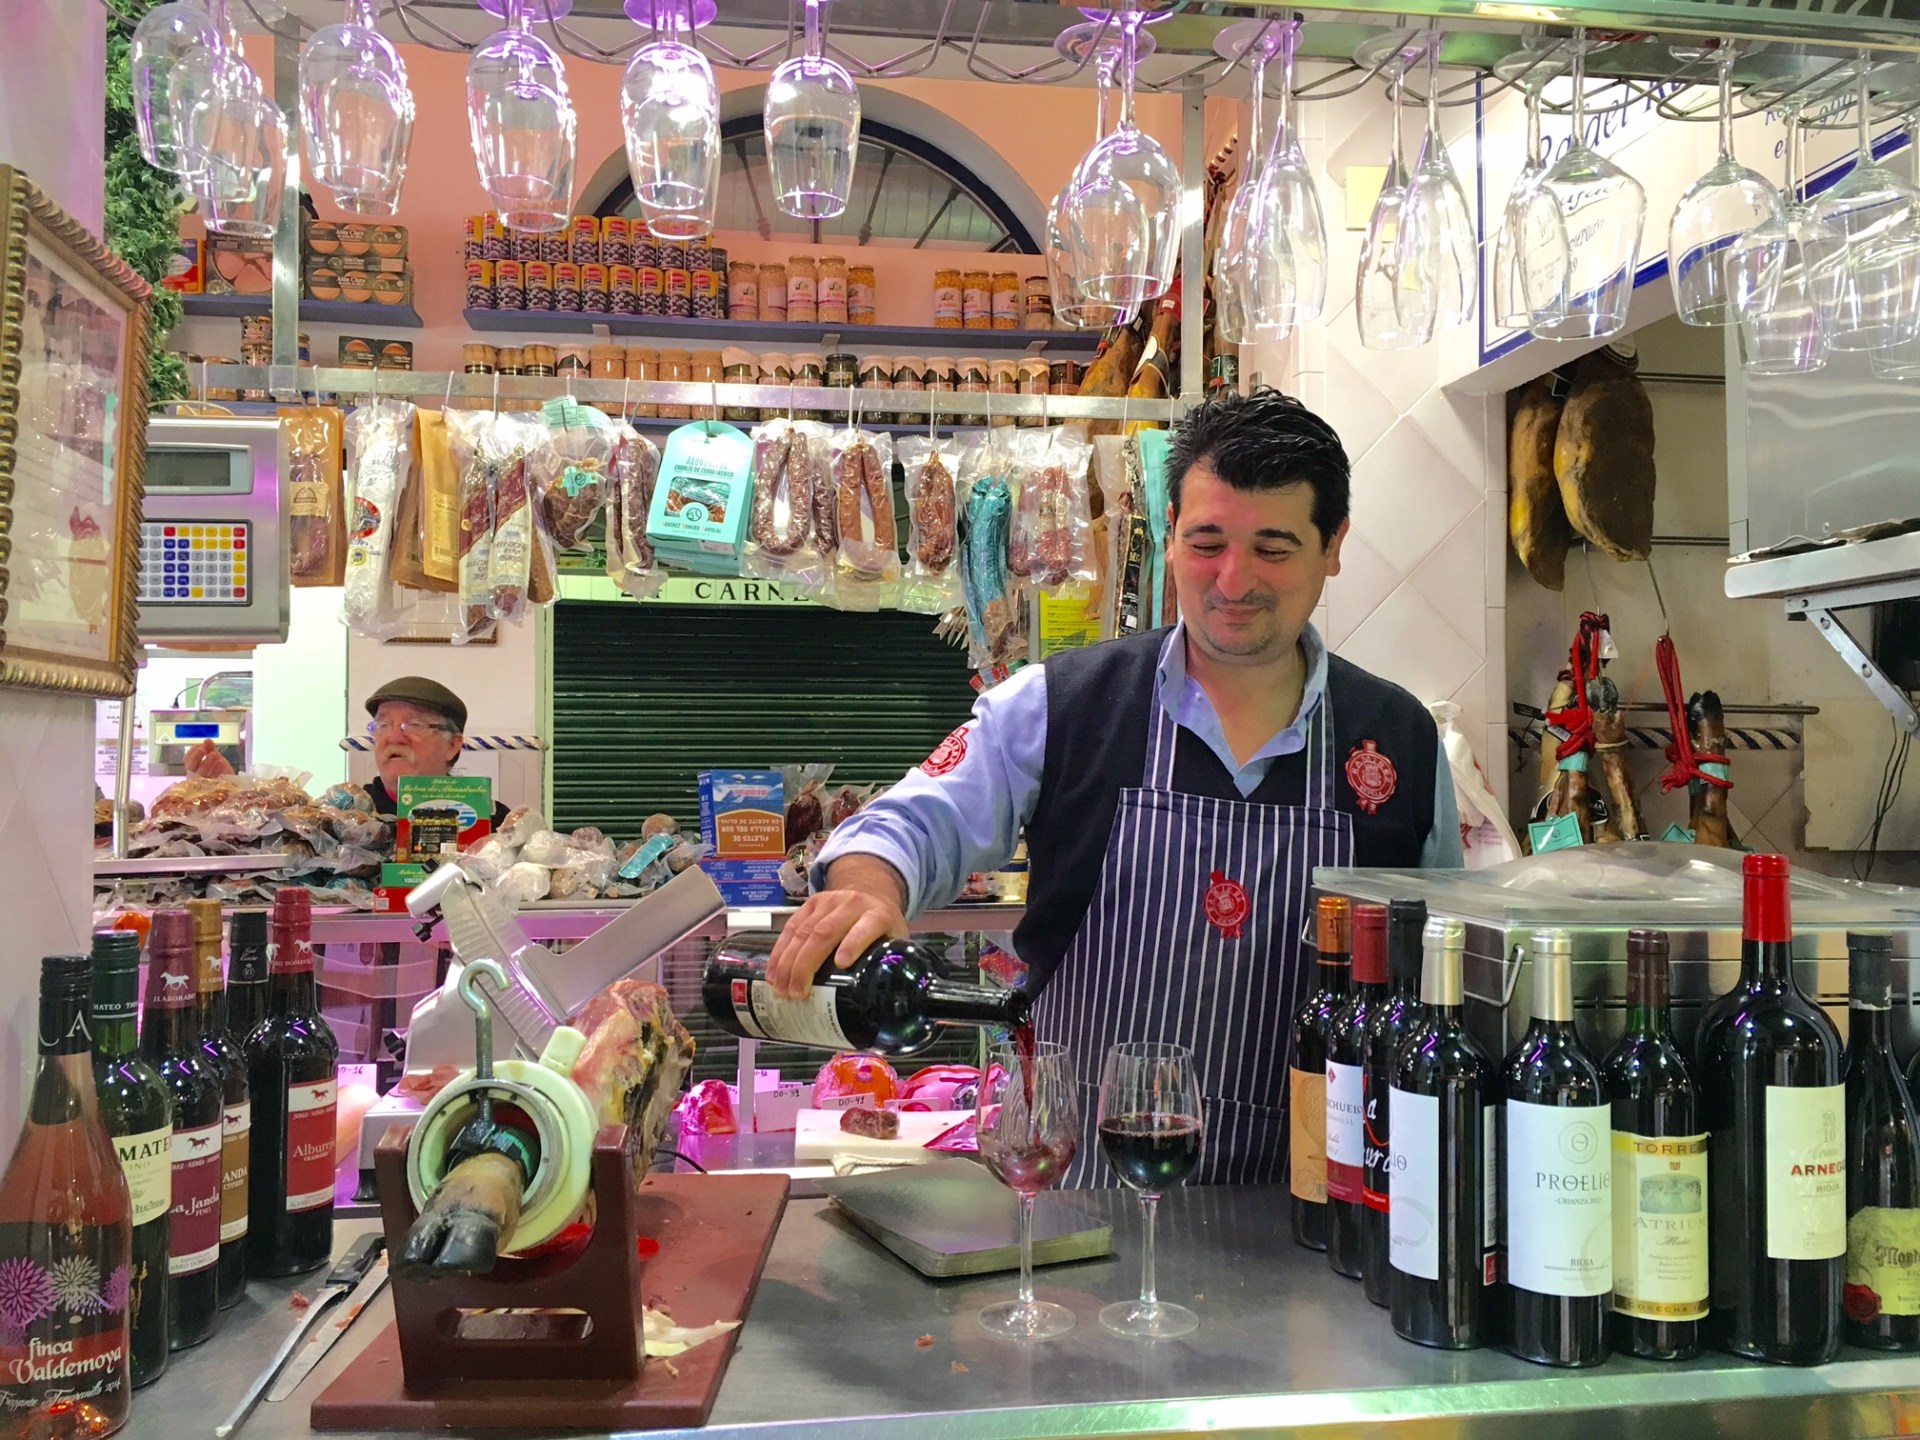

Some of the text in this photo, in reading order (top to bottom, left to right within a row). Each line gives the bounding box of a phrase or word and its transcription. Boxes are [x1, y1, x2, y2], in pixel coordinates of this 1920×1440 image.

[1633, 1141, 1707, 1155] TORRE
[1570, 1258, 1594, 1267] RIOJA
[29, 1337, 74, 1360] finca
[9, 1346, 122, 1384] Valdemoya
